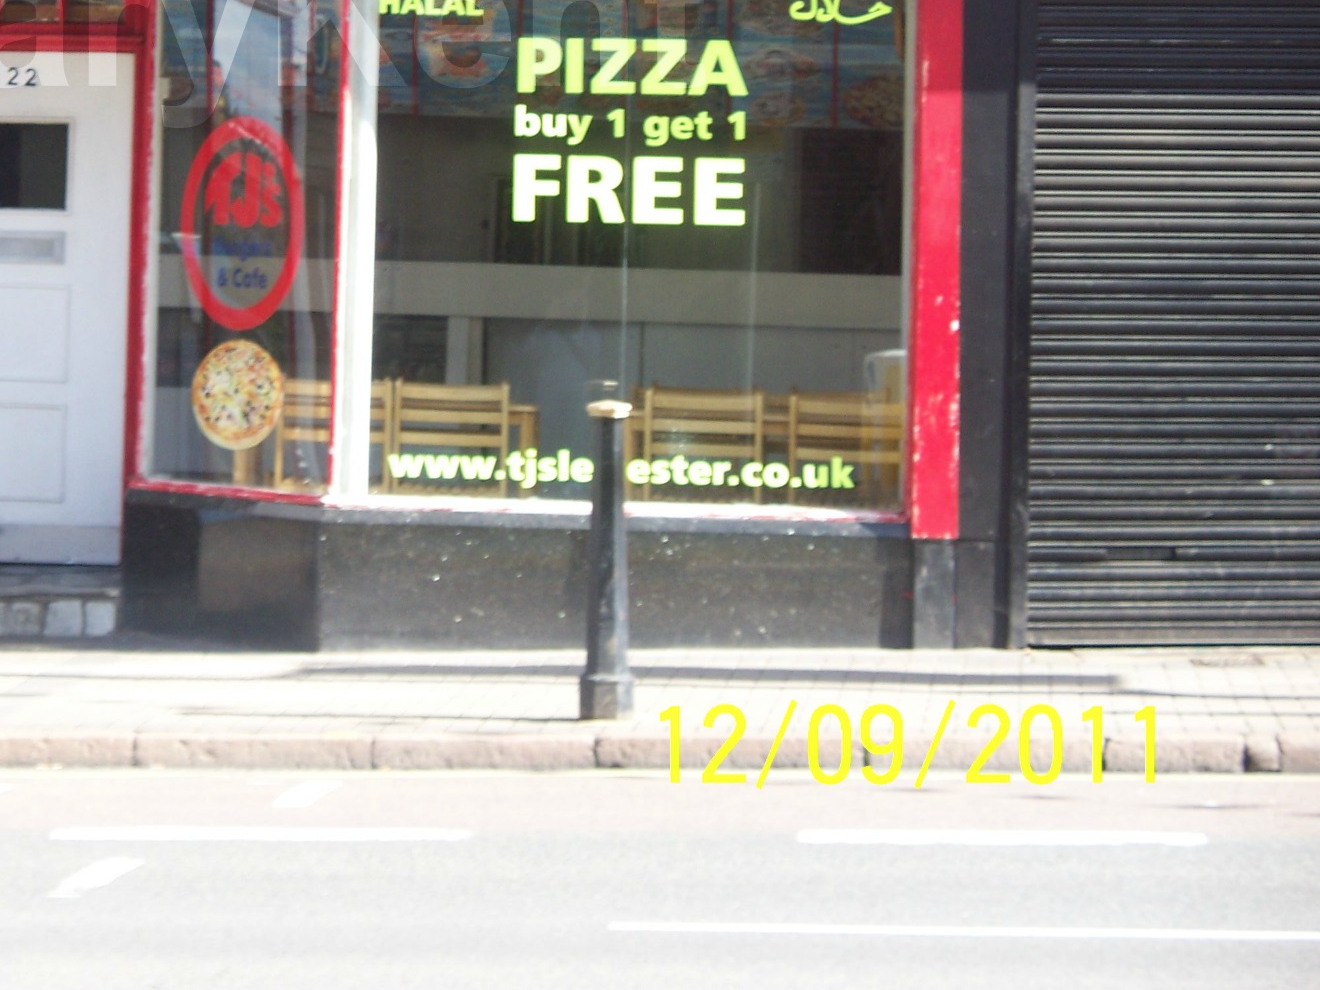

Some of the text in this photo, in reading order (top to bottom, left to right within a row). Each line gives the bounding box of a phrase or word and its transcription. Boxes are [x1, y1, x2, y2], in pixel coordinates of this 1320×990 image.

[516, 36, 749, 97] PIZZA
[513, 104, 747, 147] buy 1 get 1
[511, 153, 747, 227] FREE
[387, 448, 856, 490] www.tjsleester.co.uk
